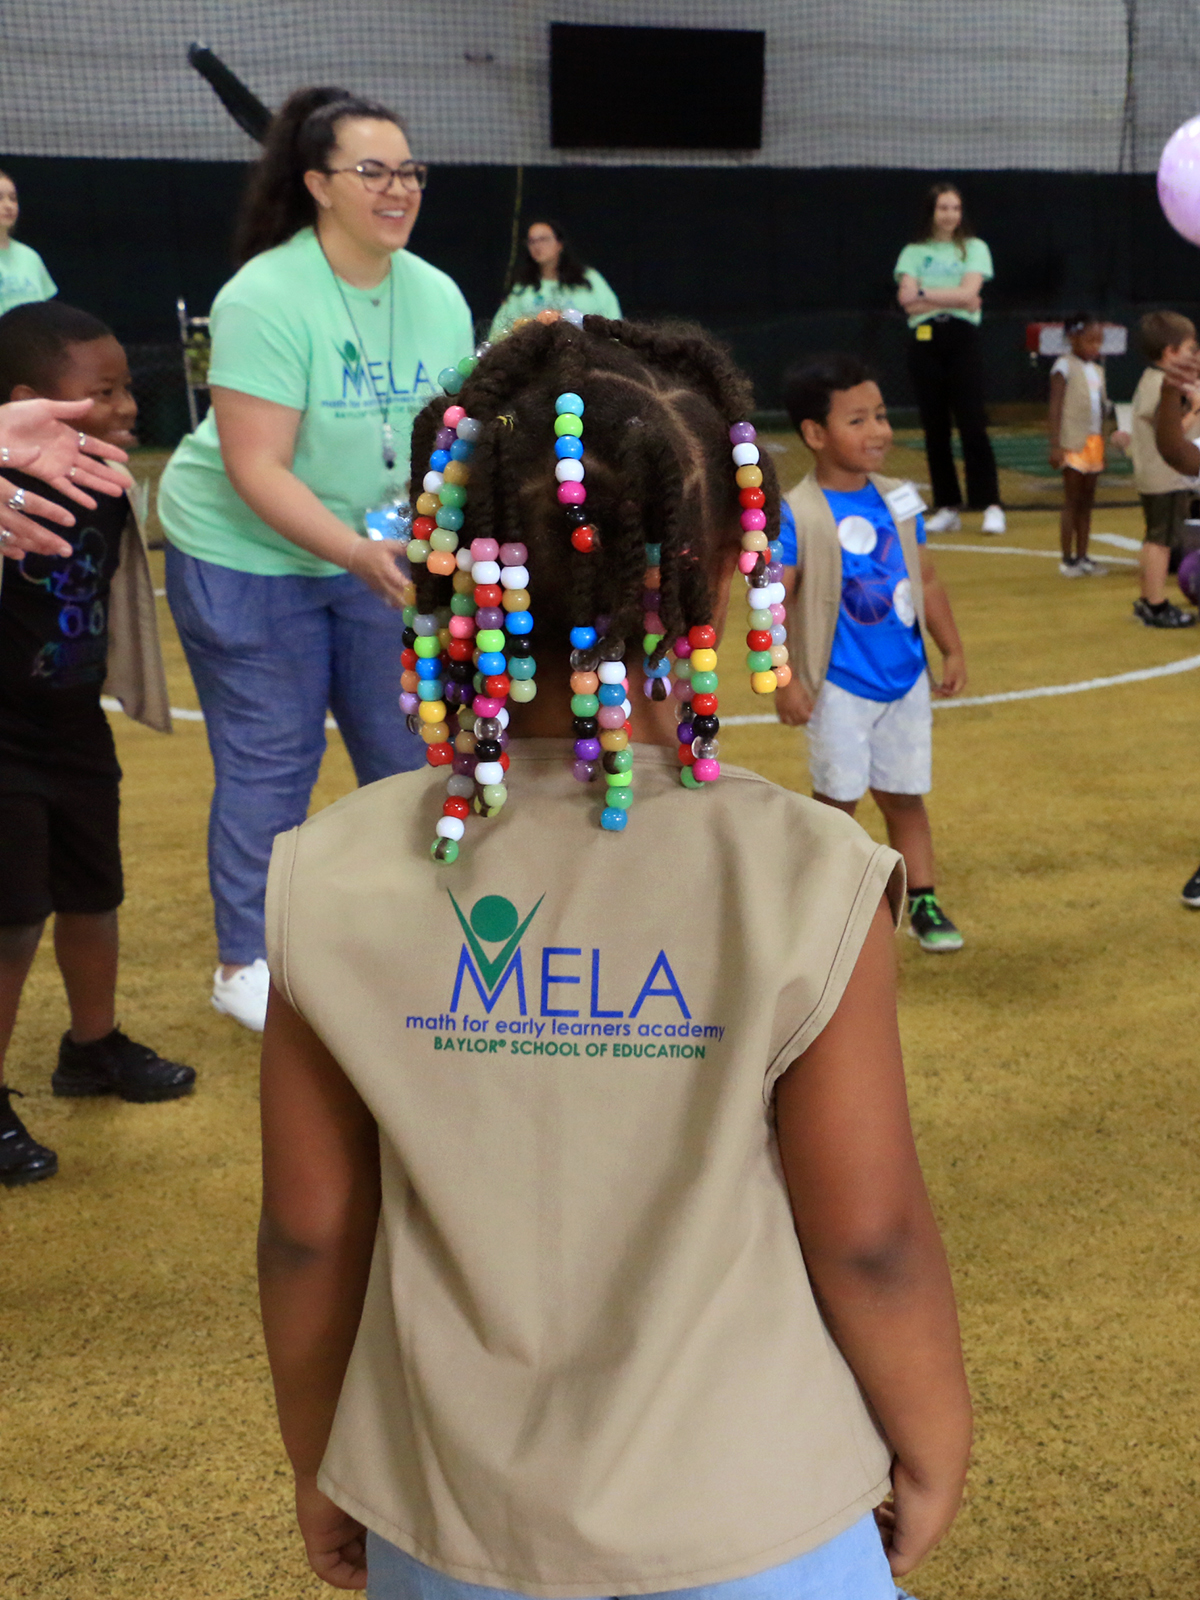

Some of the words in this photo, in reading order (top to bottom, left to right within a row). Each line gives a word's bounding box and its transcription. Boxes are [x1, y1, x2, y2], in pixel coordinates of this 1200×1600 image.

[342, 360, 437, 398] MELA
[450, 942, 692, 1020] MELA
[406, 1013, 456, 1031] math
[462, 1014, 490, 1033] for
[495, 1017, 546, 1039] early
[551, 1018, 631, 1037] learners
[637, 1020, 726, 1043] academy
[510, 1040, 581, 1057] SCHOOL
[585, 1042, 608, 1058] OF
[612, 1043, 706, 1060] EDUCATION
